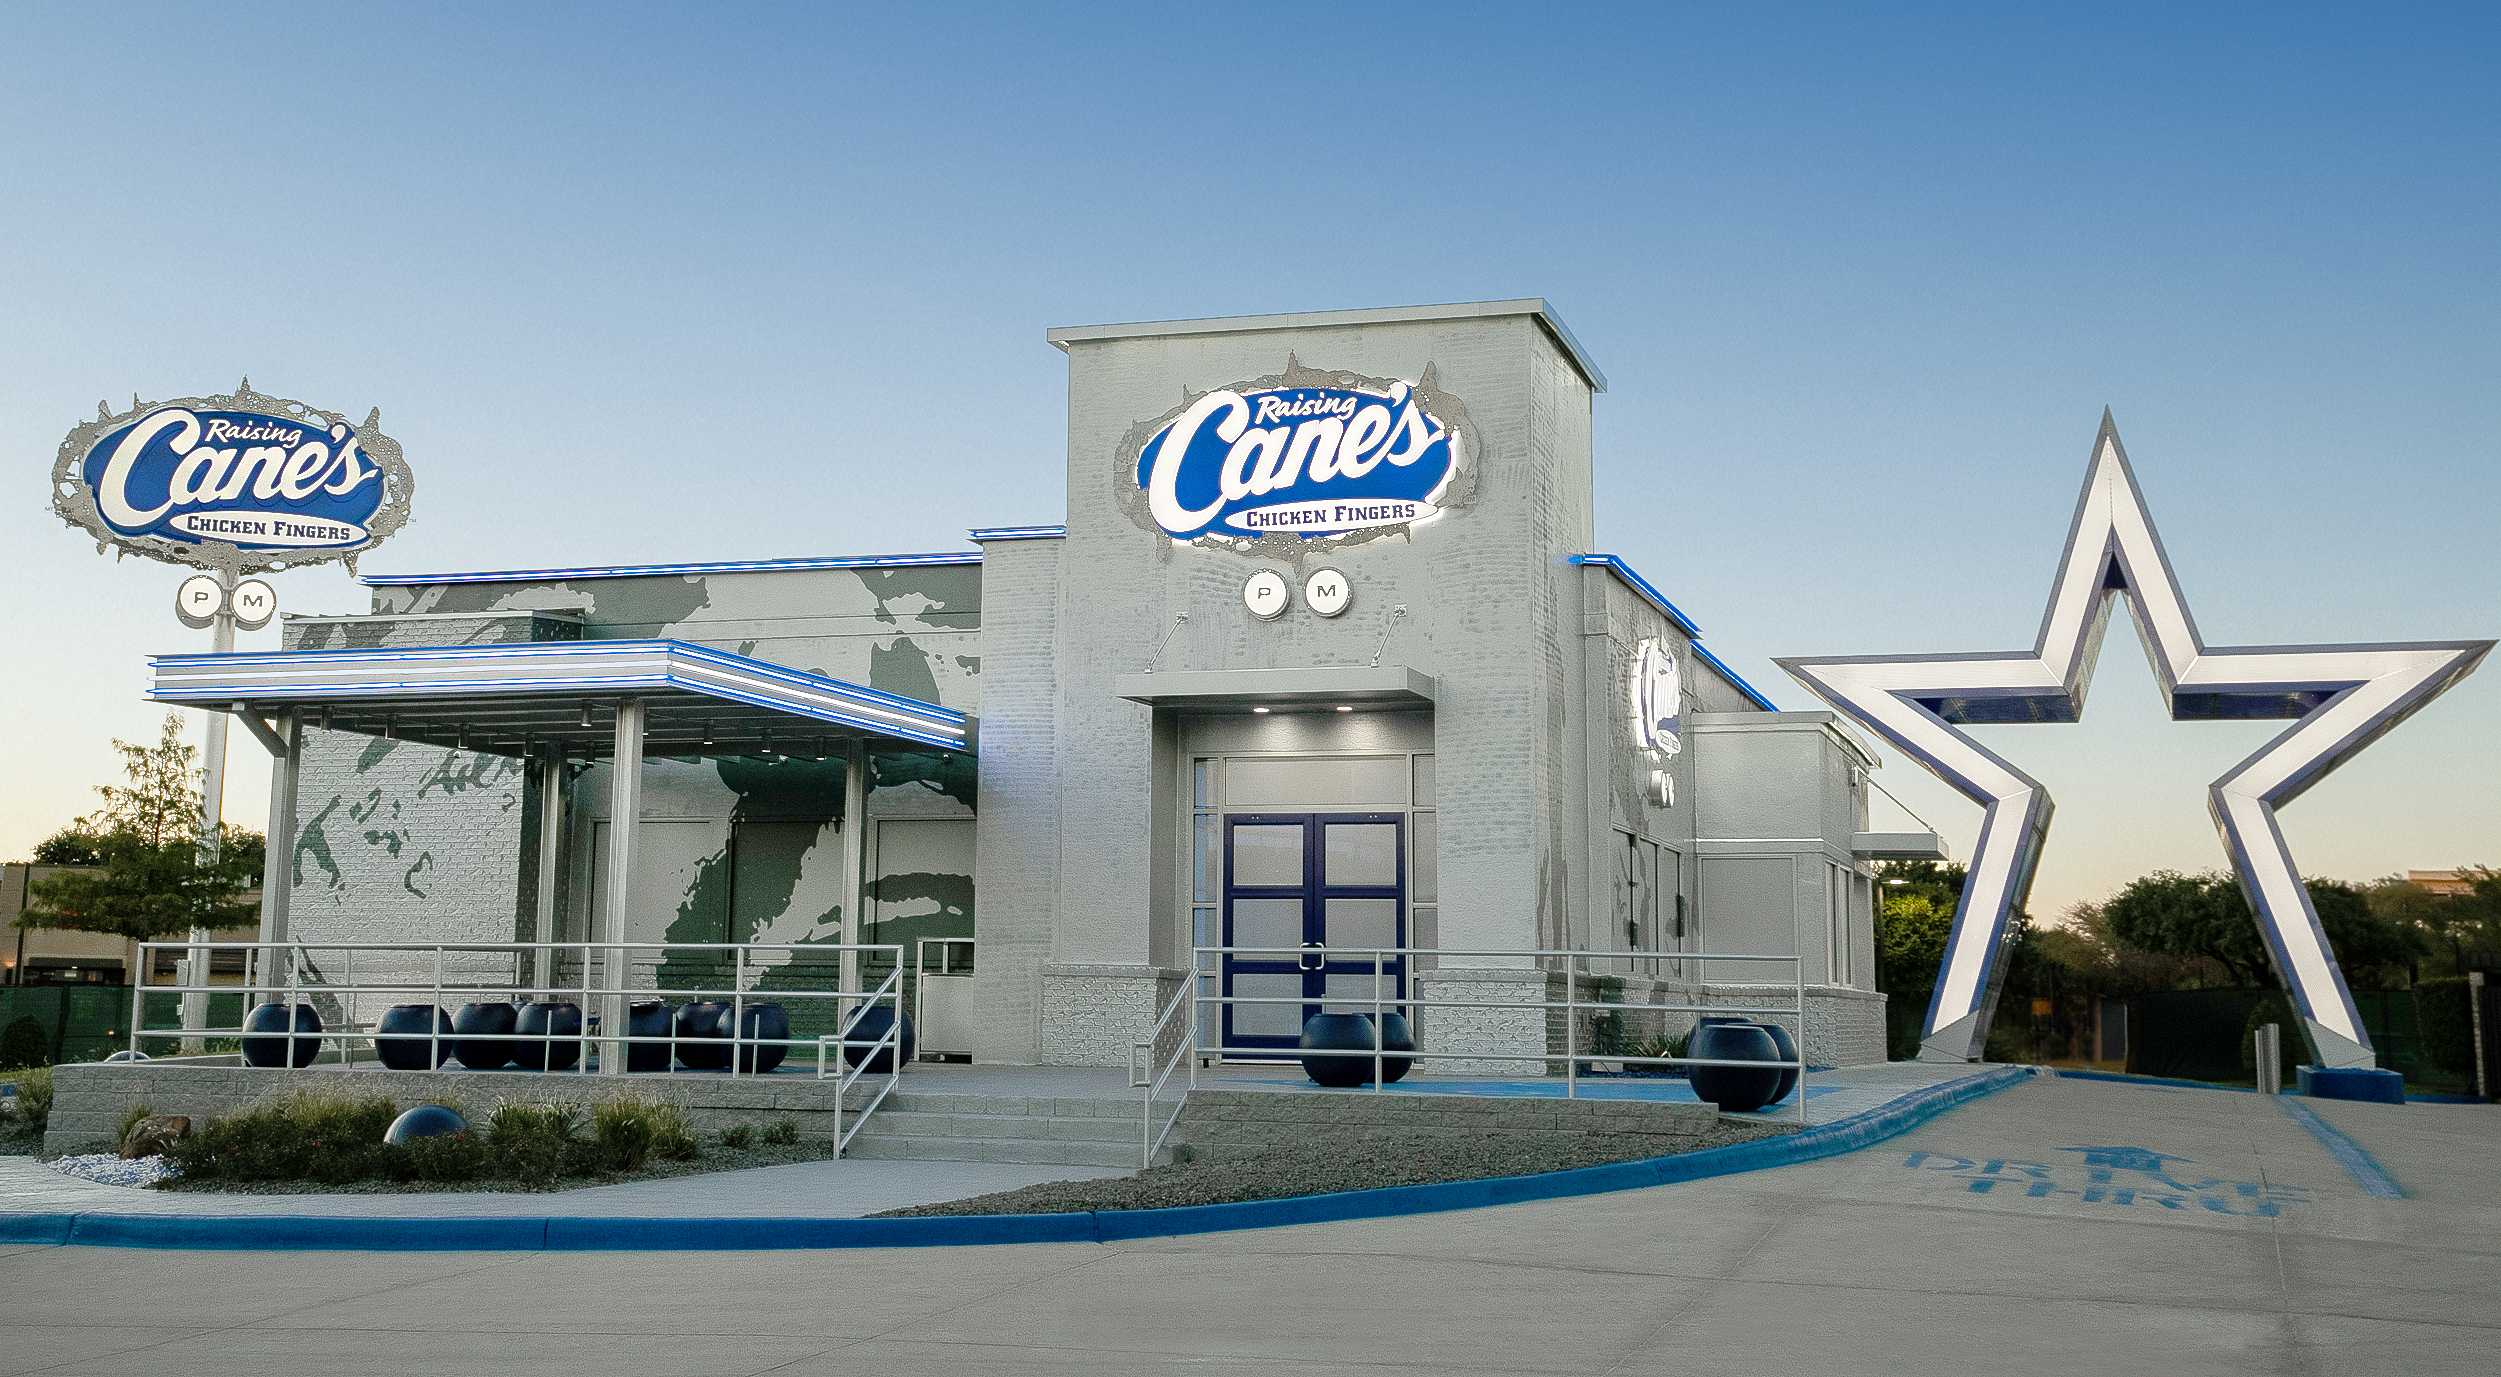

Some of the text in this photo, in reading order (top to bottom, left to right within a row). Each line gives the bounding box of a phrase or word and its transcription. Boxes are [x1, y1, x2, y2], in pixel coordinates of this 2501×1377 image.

[1255, 392, 1358, 424] Raising
[205, 419, 302, 448] Raising
[99, 407, 379, 527] Cane's
[1148, 381, 1446, 533] Cane's
[187, 515, 350, 540] CHICKEN FINGERS
[1246, 503, 1416, 528] CHICKEN FINGERS
[194, 591, 263, 607] P M
[1258, 585, 1336, 599] P M
[1952, 1174, 2281, 1217] THRU
